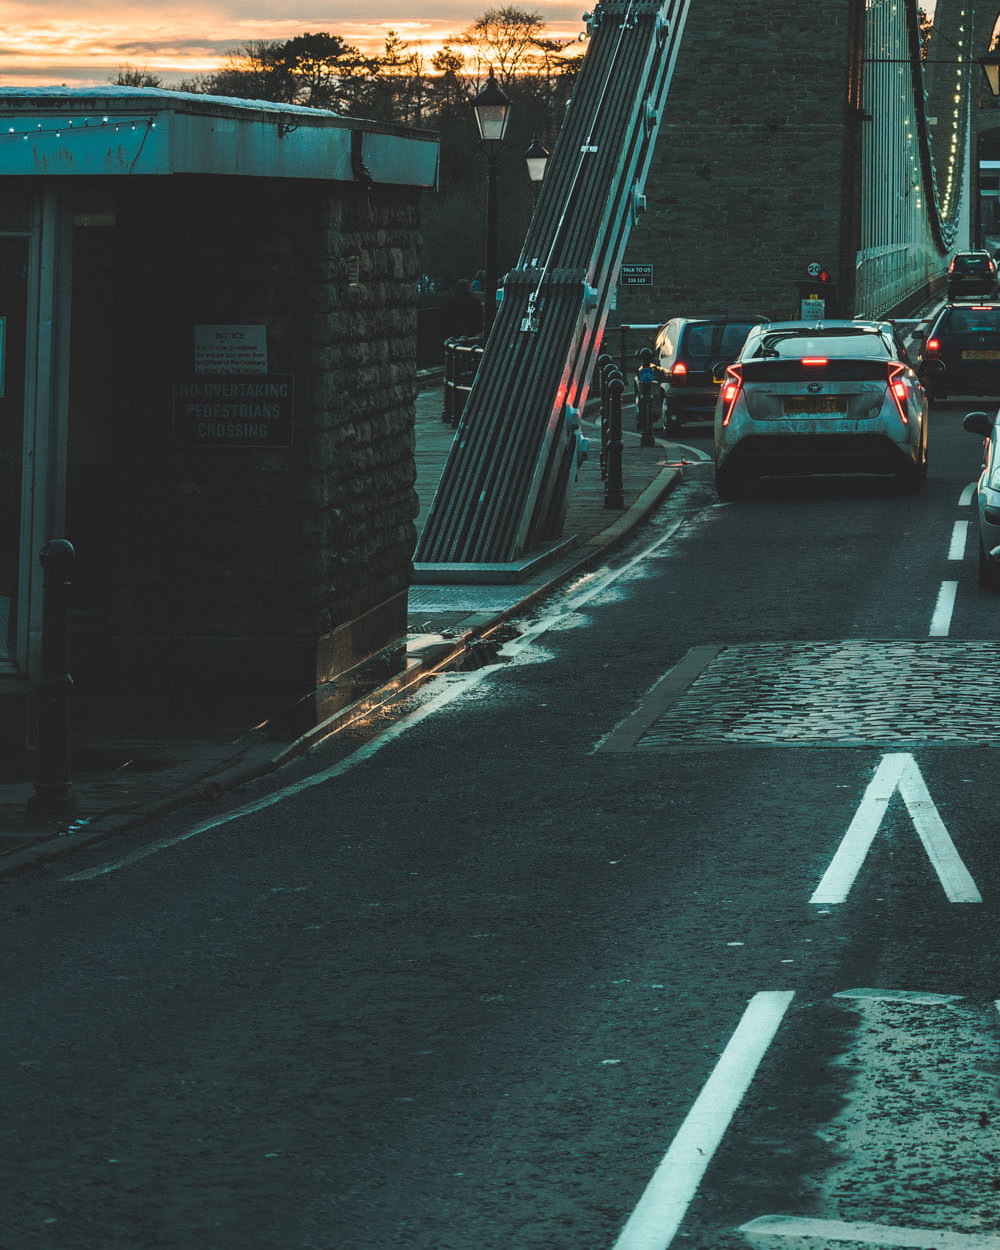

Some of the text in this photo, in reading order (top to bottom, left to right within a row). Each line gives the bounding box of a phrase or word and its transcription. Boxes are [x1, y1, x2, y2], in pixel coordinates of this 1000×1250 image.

[808, 265, 820, 273] 20
[179, 382, 288, 398] NO OVERTAKING
[186, 403, 281, 418] PEDESTRIANS
[198, 423, 268, 438] CROSSING
